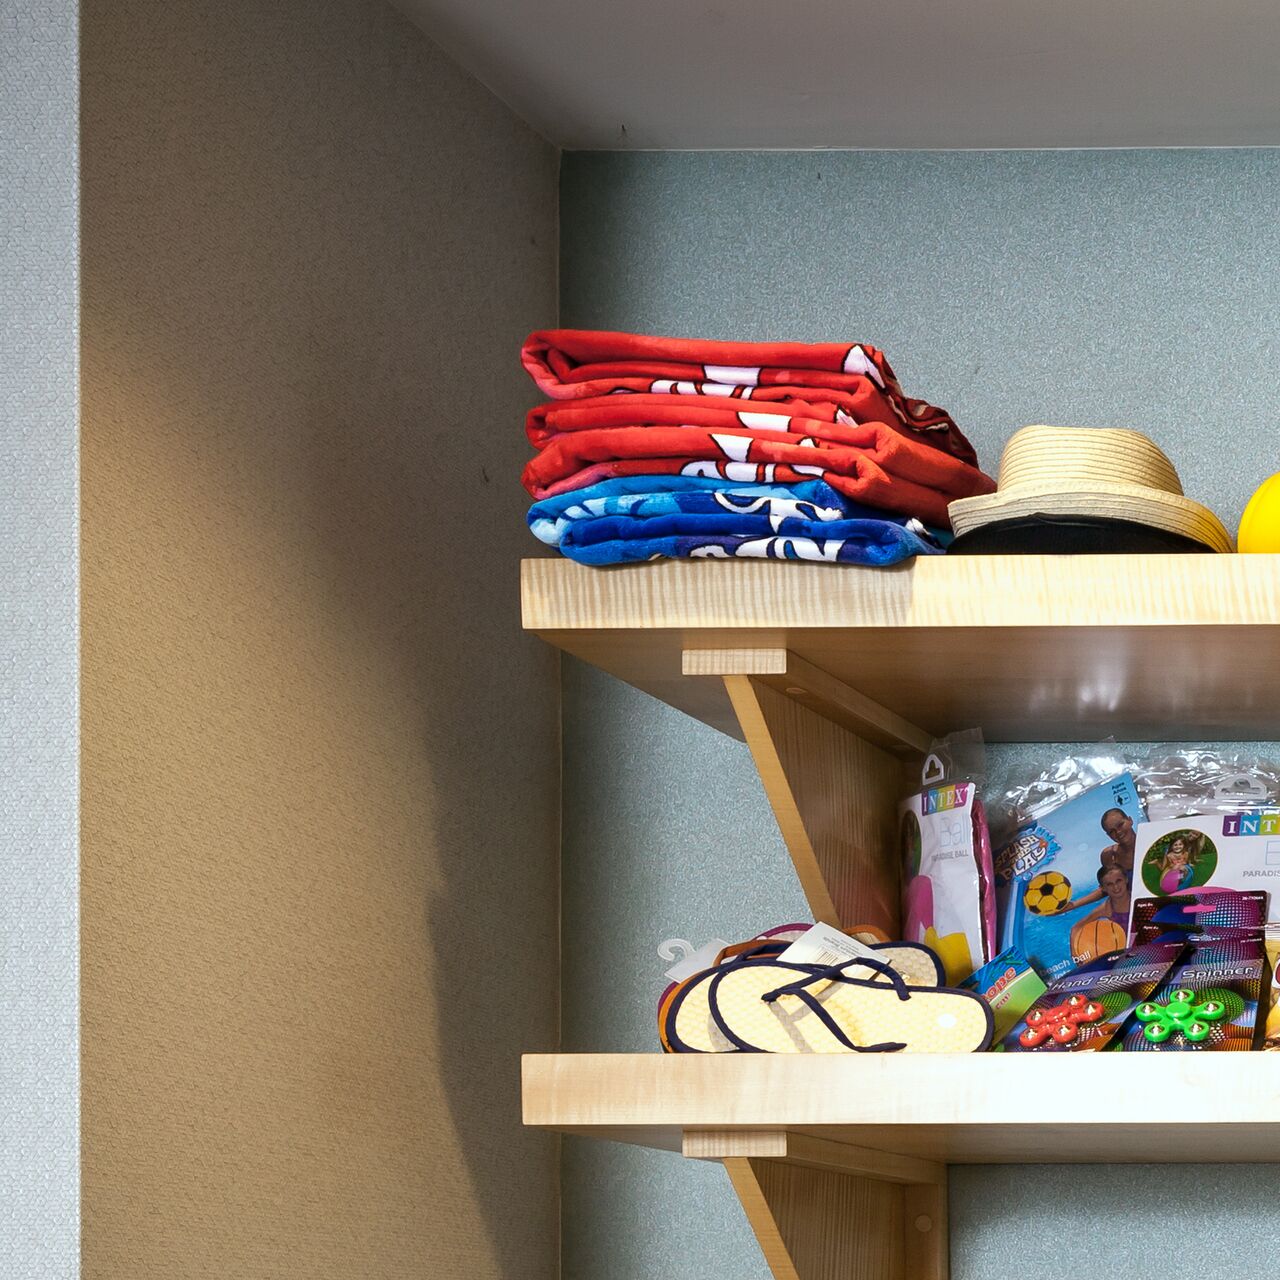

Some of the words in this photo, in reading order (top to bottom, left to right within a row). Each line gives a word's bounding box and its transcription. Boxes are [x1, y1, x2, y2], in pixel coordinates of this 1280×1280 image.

[923, 788, 967, 812] INTEX
[1099, 968, 1160, 984] Spinner
[1182, 967, 1254, 980] Spinner
